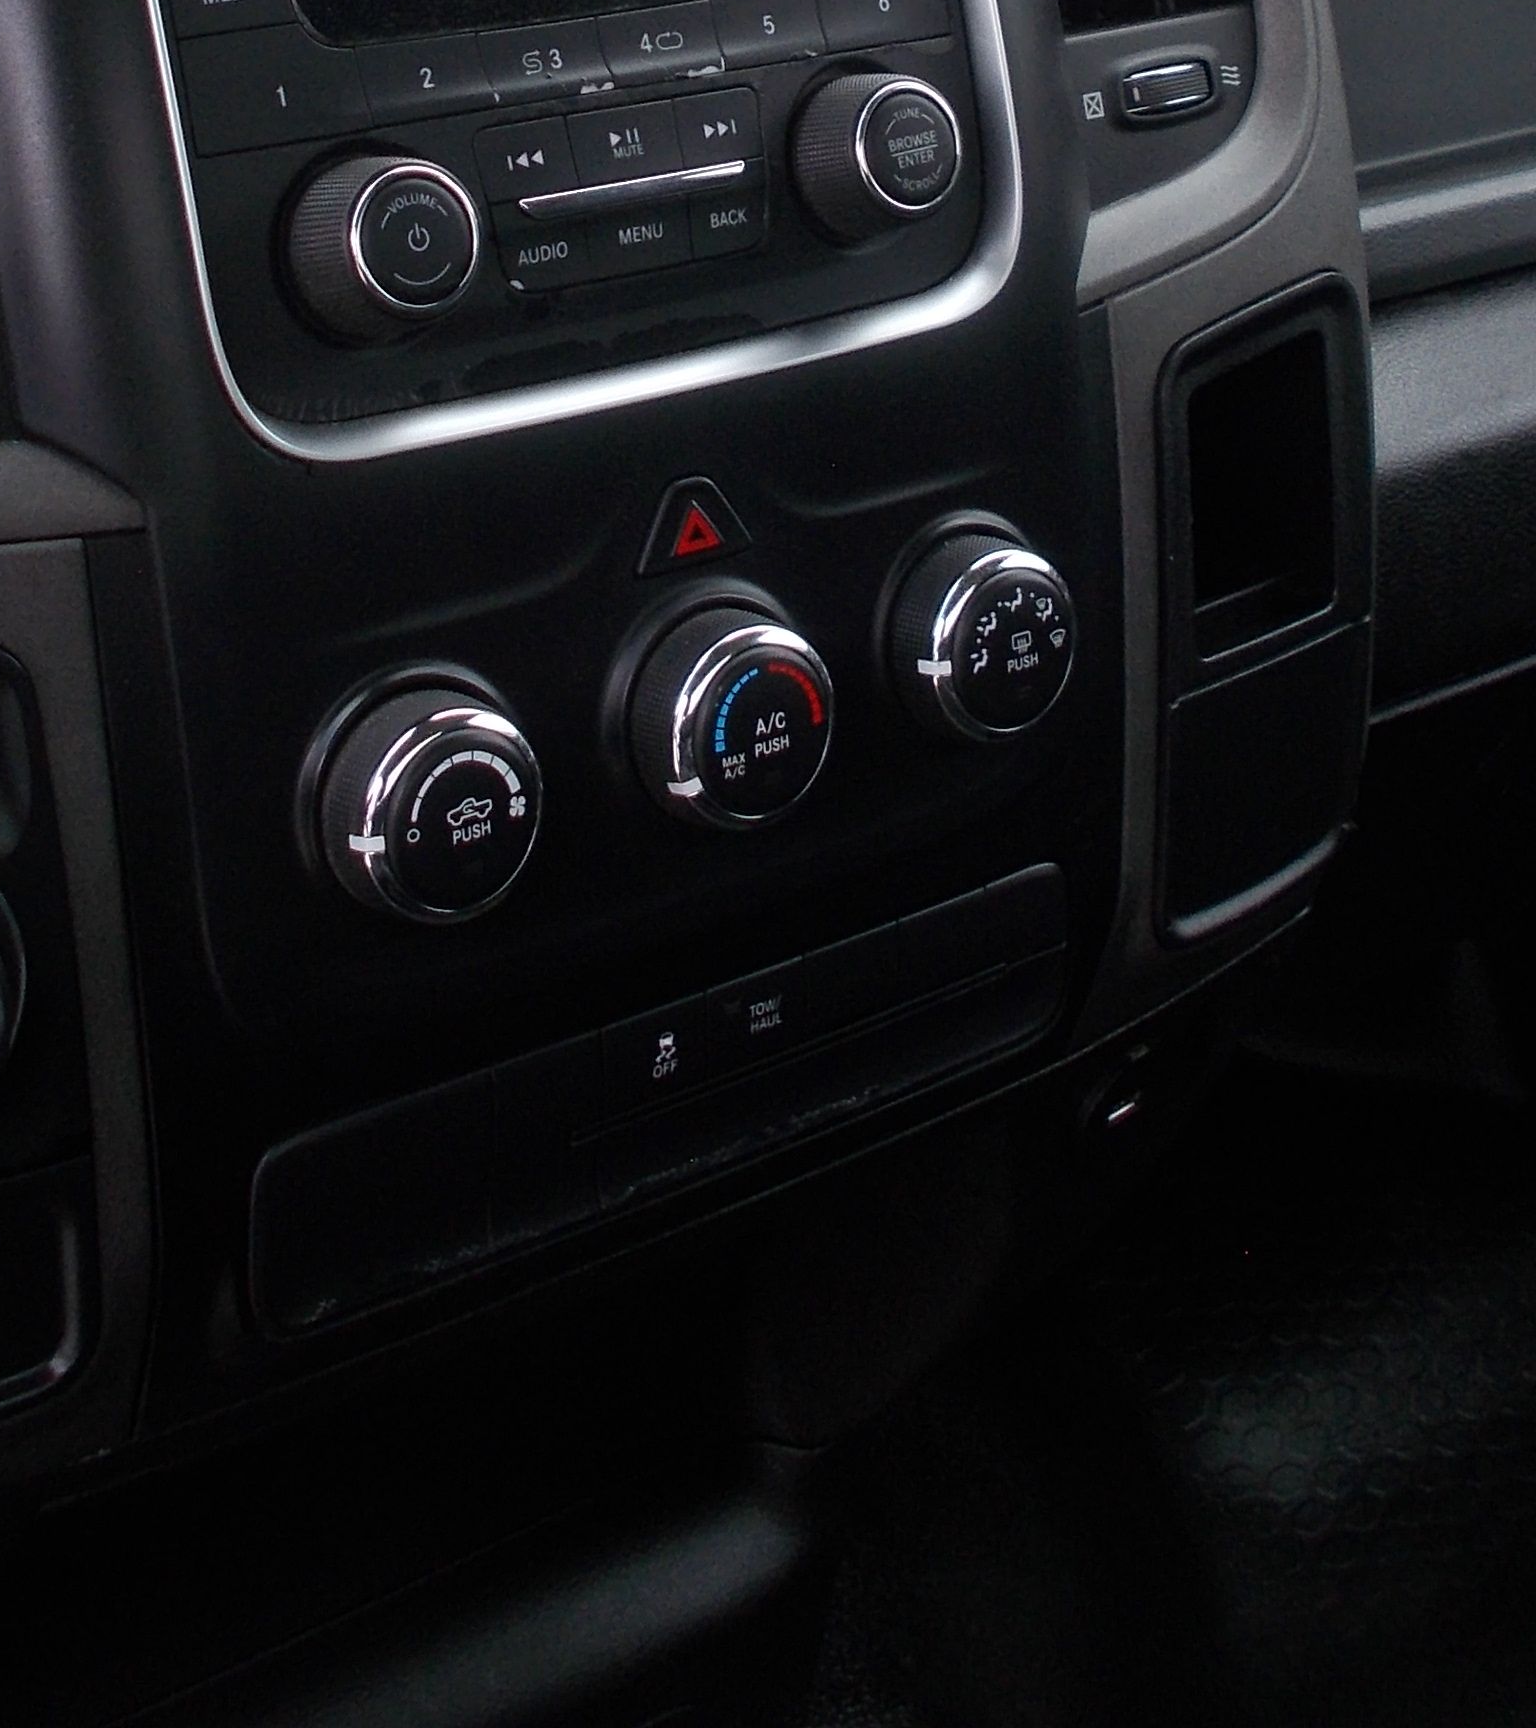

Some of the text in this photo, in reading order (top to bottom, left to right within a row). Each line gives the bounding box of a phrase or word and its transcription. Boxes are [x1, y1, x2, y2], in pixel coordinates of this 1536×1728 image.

[762, 15, 775, 35] 5
[640, 32, 653, 53] 4
[549, 48, 563, 70] 3
[419, 67, 435, 89] 2
[275, 85, 287, 108] 1
[894, 107, 921, 122] TUNE
[613, 143, 645, 159] MUTE
[888, 130, 938, 153] BROWSE
[897, 149, 936, 169] ENTER
[901, 171, 941, 191] SCROLL
[387, 191, 438, 215] VOLUME
[710, 207, 748, 229] BACK
[618, 222, 664, 246] MENU
[517, 240, 569, 267] AUDIO
[1007, 652, 1040, 673] PUSH
[755, 711, 786, 737] A/C
[754, 733, 790, 758] PUSH
[722, 752, 746, 769] MAX
[724, 764, 746, 780] A/C
[452, 819, 492, 846] PUSH
[750, 1012, 783, 1035] HAUL
[652, 1058, 679, 1079] OFF
